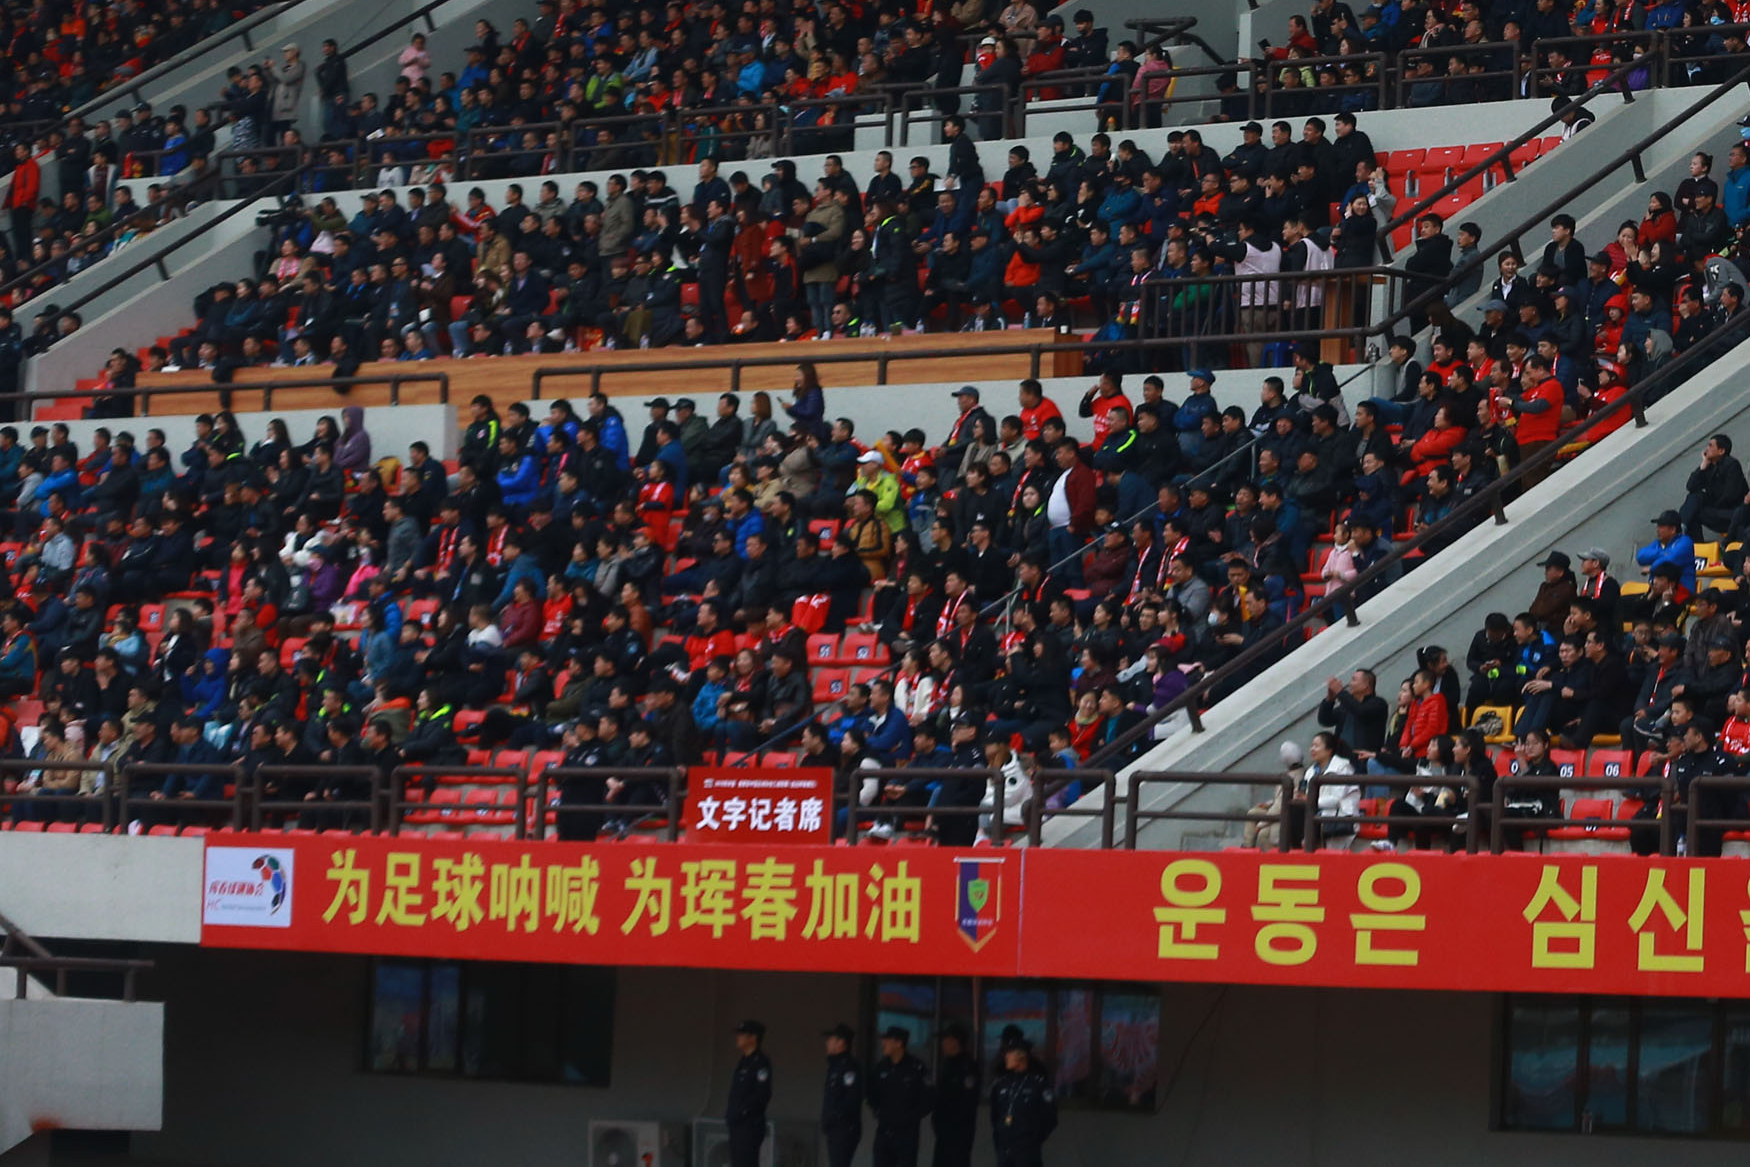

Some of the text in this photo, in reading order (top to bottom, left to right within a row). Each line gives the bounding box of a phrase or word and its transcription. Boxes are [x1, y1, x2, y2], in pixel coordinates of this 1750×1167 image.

[1560, 763, 1574, 777] 05
[1605, 763, 1620, 777] 06
[696, 795, 823, 832] 文字记者席
[323, 849, 922, 943] 为足球呐喊 为珲春加油
[1153, 859, 1427, 966] 운동은
